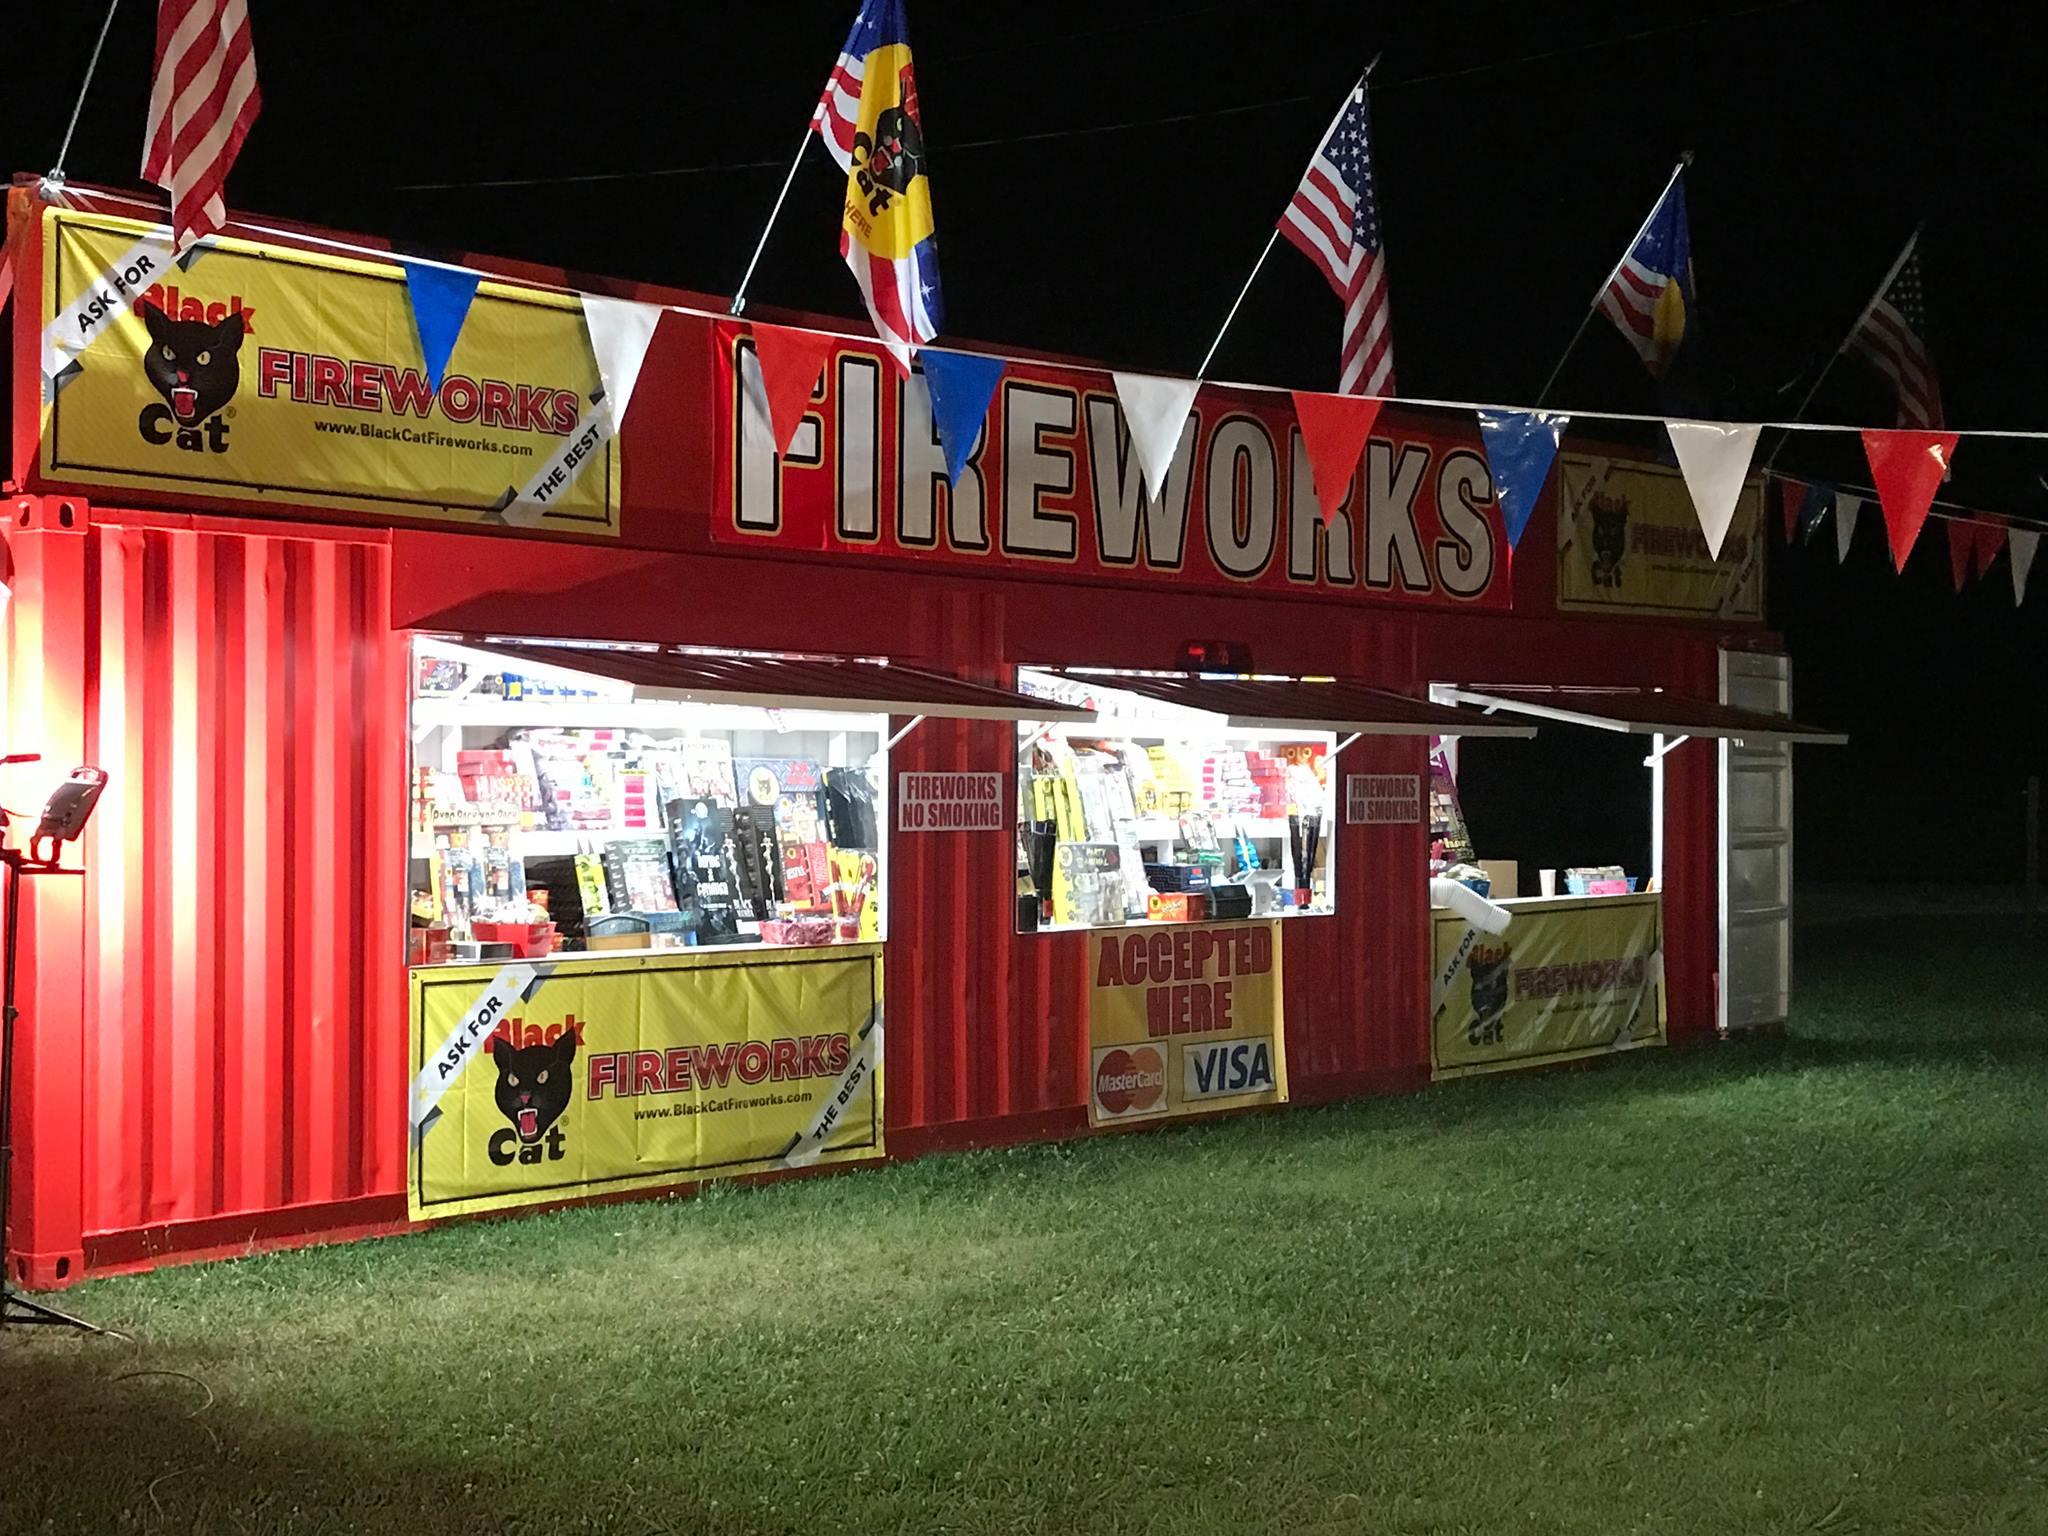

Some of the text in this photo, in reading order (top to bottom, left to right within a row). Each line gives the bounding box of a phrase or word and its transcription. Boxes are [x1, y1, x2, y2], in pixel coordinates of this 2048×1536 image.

[77, 255, 155, 333] ASK FOR
[258, 347, 580, 436] FIREWORKS
[139, 402, 230, 453] Cat
[314, 420, 533, 456] www.BlackCatFireworks.com
[533, 425, 601, 503] THE BEST
[907, 776, 996, 800] FIREWORKS
[1350, 800, 1418, 820] NO SMOKING
[1353, 778, 1416, 798] FIREWORKS
[902, 802, 1000, 827] NO SMOKING
[1097, 926, 1273, 987] ACCEPTED
[1443, 929, 1476, 985] ASK FOR
[1146, 981, 1232, 1037] HERE
[437, 996, 503, 1080] ASK FOR
[588, 1033, 850, 1101] FIREWORKS
[1098, 1069, 1163, 1094] MasterCard
[1192, 1043, 1273, 1093] VISA
[634, 1091, 812, 1121] www.BlackCatFireworks.com
[813, 1057, 867, 1140] THE BEST
[488, 1125, 566, 1166] Cat
